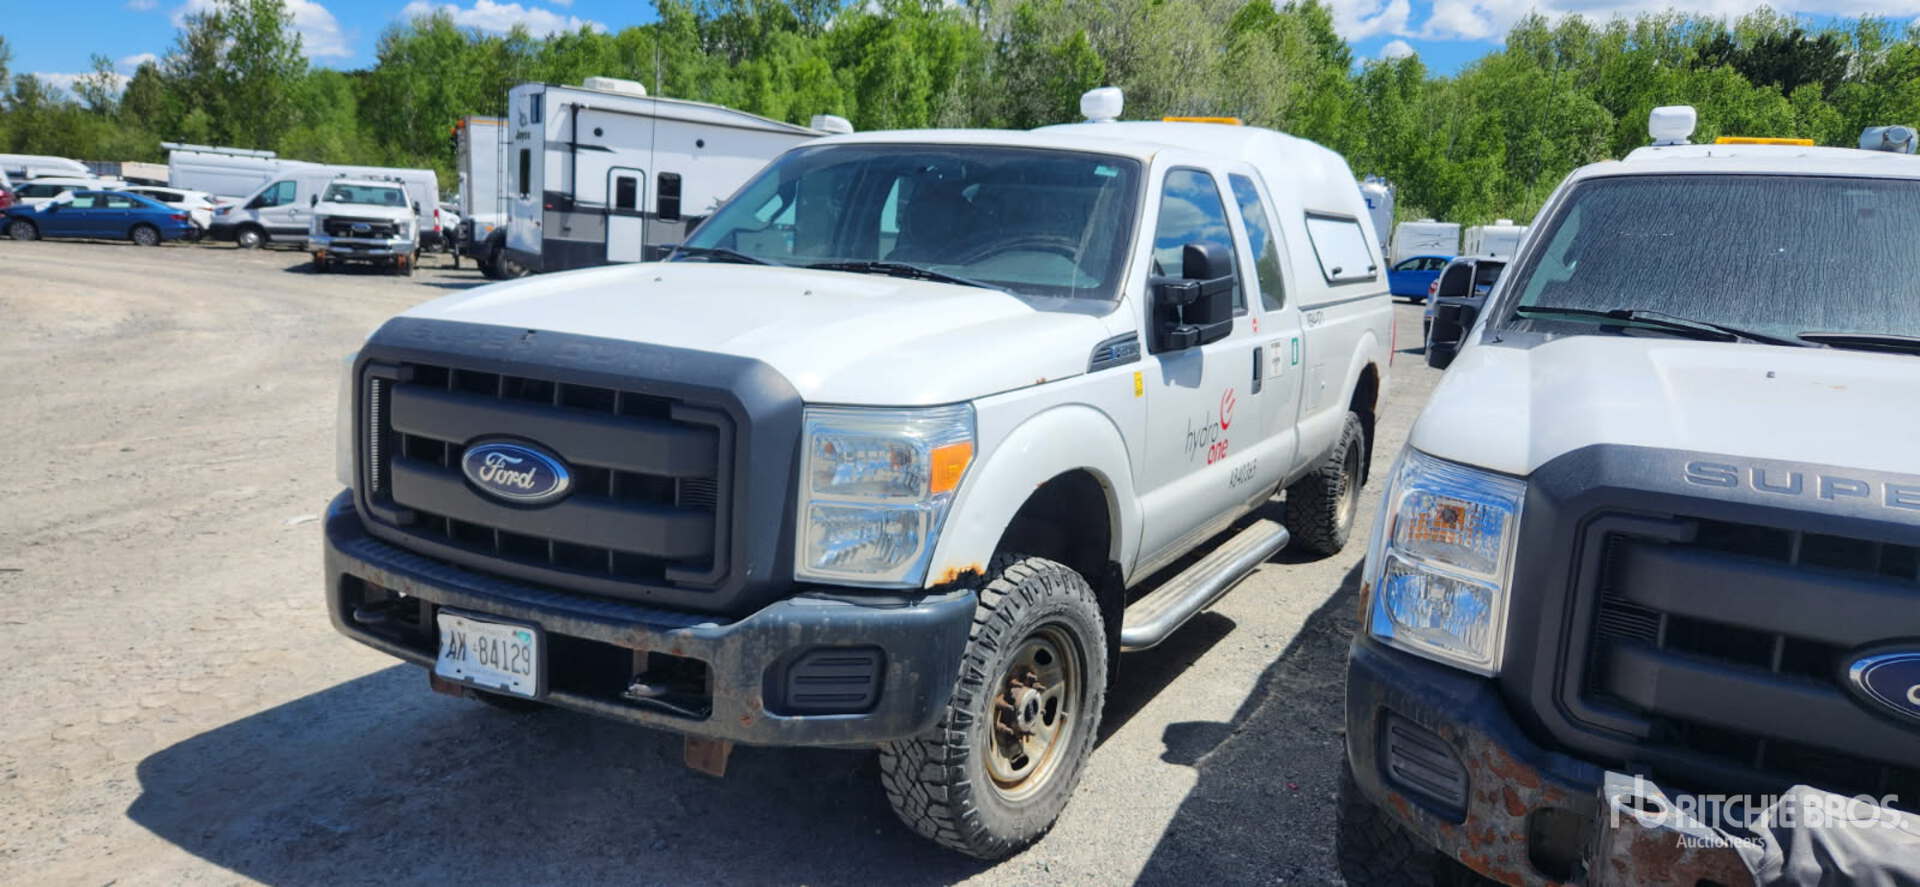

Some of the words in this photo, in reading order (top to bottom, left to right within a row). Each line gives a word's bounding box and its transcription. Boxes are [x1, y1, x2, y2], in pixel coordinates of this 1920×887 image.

[1185, 411, 1218, 462] hydro
[1207, 439, 1229, 465] one
[479, 452, 537, 489] Ford
